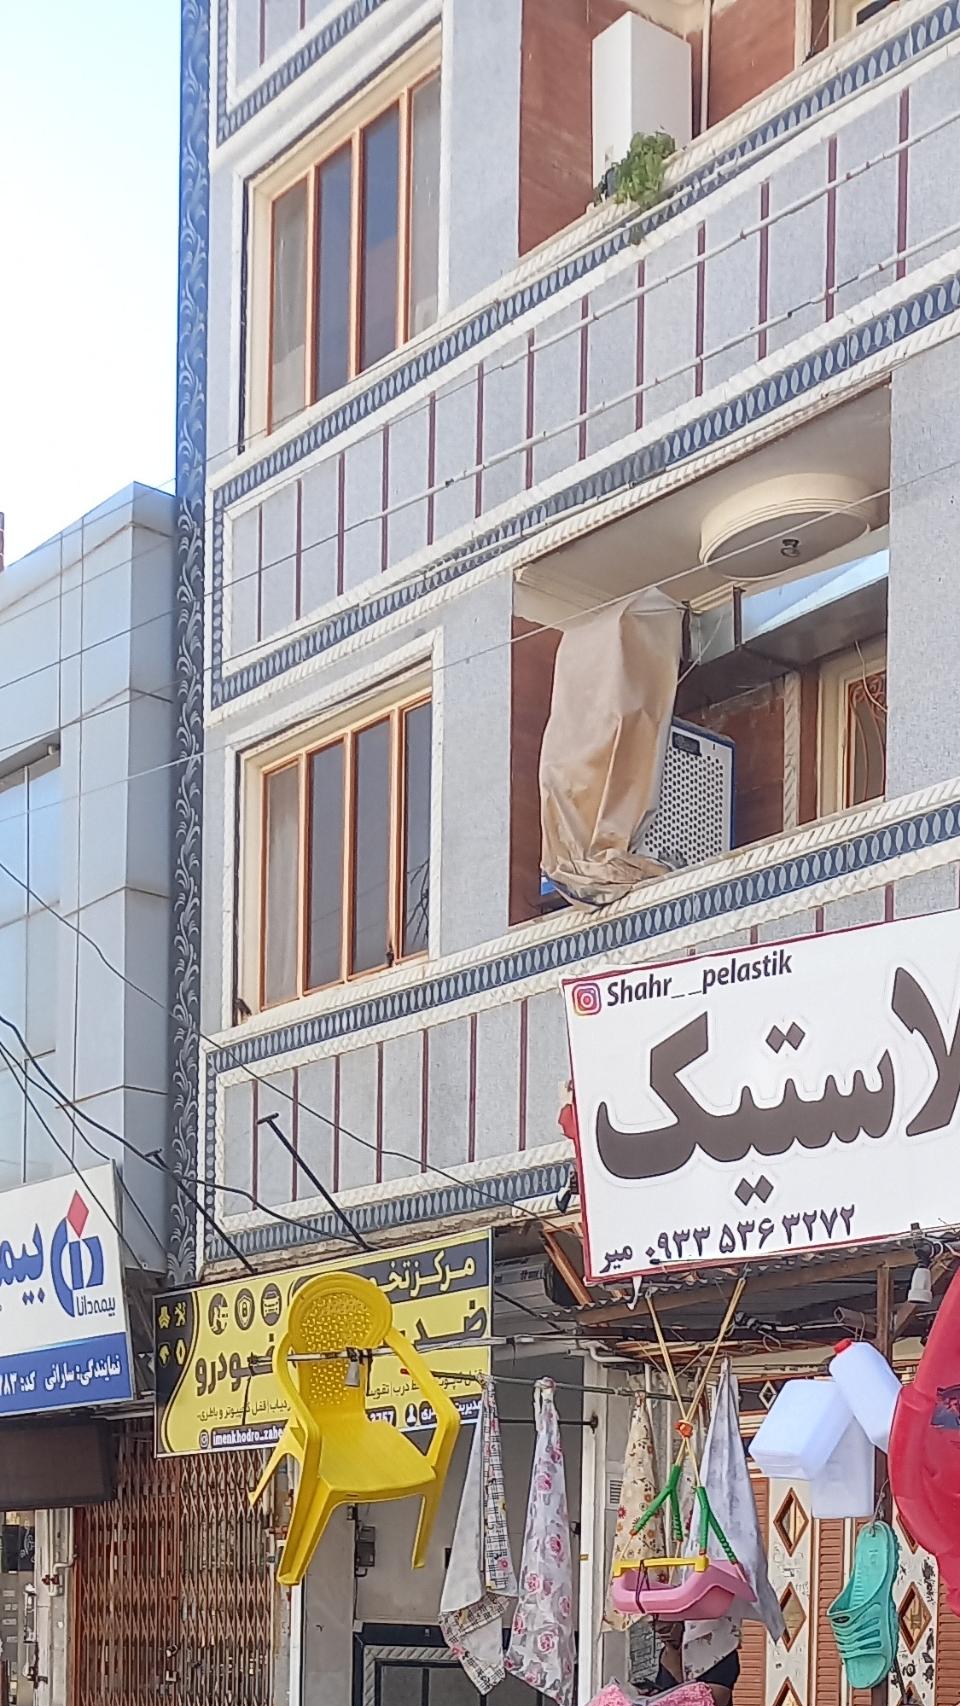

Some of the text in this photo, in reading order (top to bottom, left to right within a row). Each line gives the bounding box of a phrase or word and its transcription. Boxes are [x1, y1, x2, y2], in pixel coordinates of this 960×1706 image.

[600, 1204, 856, 1273] ۰۹۳۳ ۵۳۶ ۳۲۷۲ میر
[410, 1249, 477, 1298] مرکز
